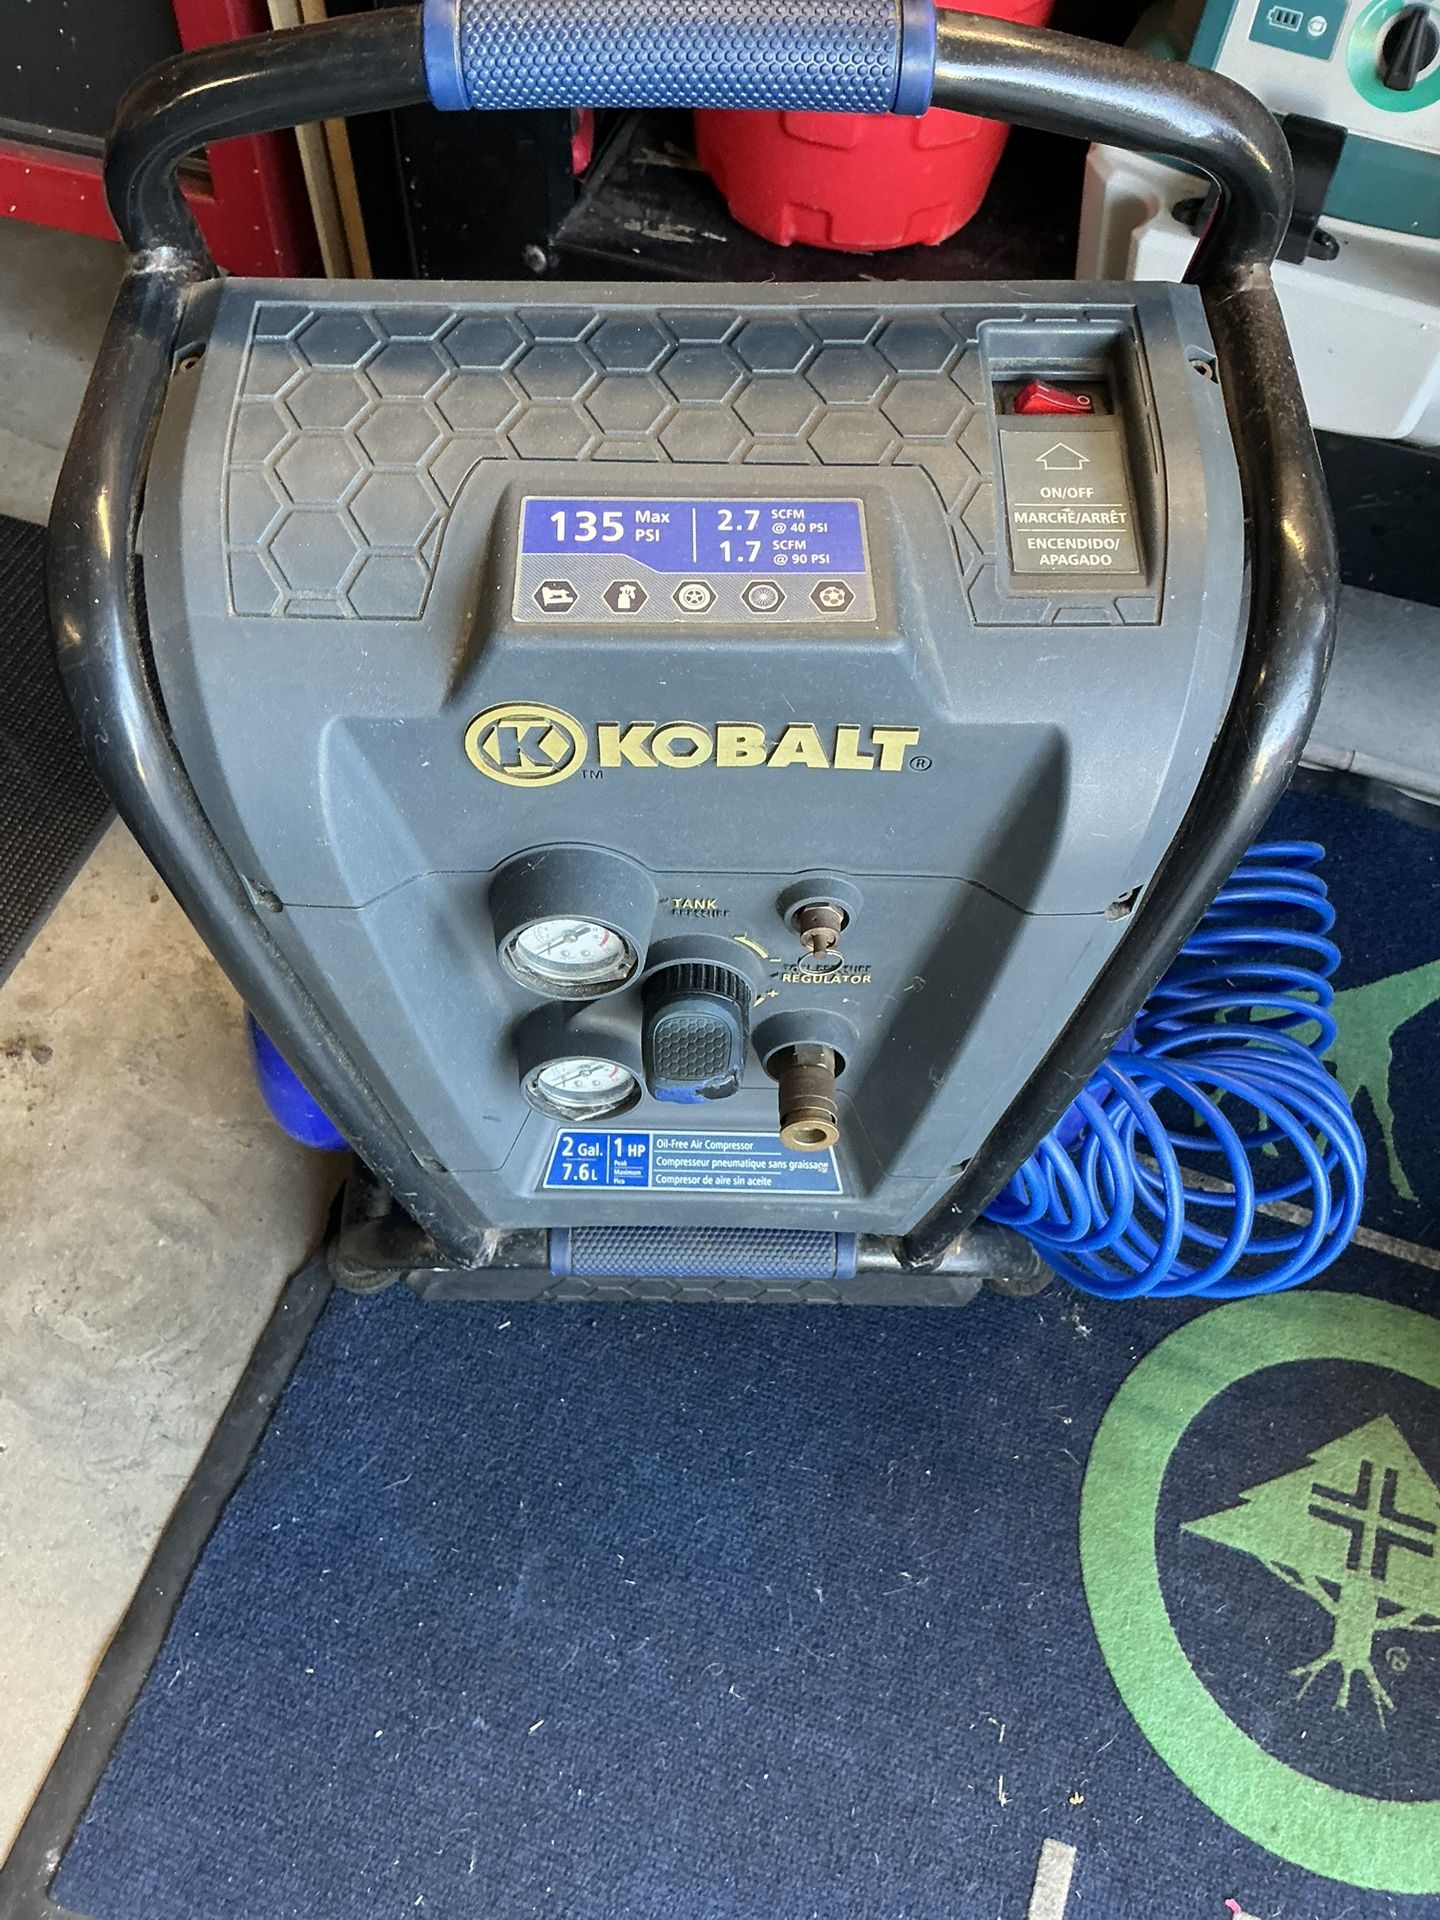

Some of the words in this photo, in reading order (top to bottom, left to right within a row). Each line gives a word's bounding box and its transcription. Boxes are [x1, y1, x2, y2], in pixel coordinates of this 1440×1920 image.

[1039, 486, 1095, 499] ON/OFF
[634, 510, 671, 525] Max
[716, 509, 760, 533] 2.7
[771, 508, 805, 520] SCFM
[549, 510, 625, 542] 135
[771, 521, 787, 535] @
[789, 521, 807, 534] 40
[808, 522, 828, 534] PSI
[634, 528, 661, 543] PSI
[718, 539, 762, 563] 1.7
[772, 539, 807, 551] SCFM
[1027, 537, 1120, 551] ENCENDIDO/
[772, 553, 789, 566] @
[790, 553, 808, 565] 90
[810, 553, 830, 565] PSI
[1039, 554, 1113, 566] APAGADO
[597, 719, 921, 772] KOBALT
[672, 897, 718, 910] TANK
[781, 973, 872, 984] REGULATOR
[561, 1136, 575, 1157] 2
[577, 1142, 603, 1157] Gal.
[613, 1137, 623, 1157] 1
[627, 1143, 647, 1158] HP
[656, 1138, 689, 1149] Oil-Free
[690, 1140, 703, 1149] Air
[704, 1140, 754, 1152] Compressor
[655, 1156, 710, 1169] Compresseur
[711, 1158, 767, 1172] pneumatique
[768, 1161, 787, 1170] sans
[655, 1174, 701, 1187] Compresor
[702, 1175, 714, 1185] de
[714, 1176, 732, 1186] aire
[733, 1176, 746, 1186] sin
[746, 1176, 773, 1187] aceite
